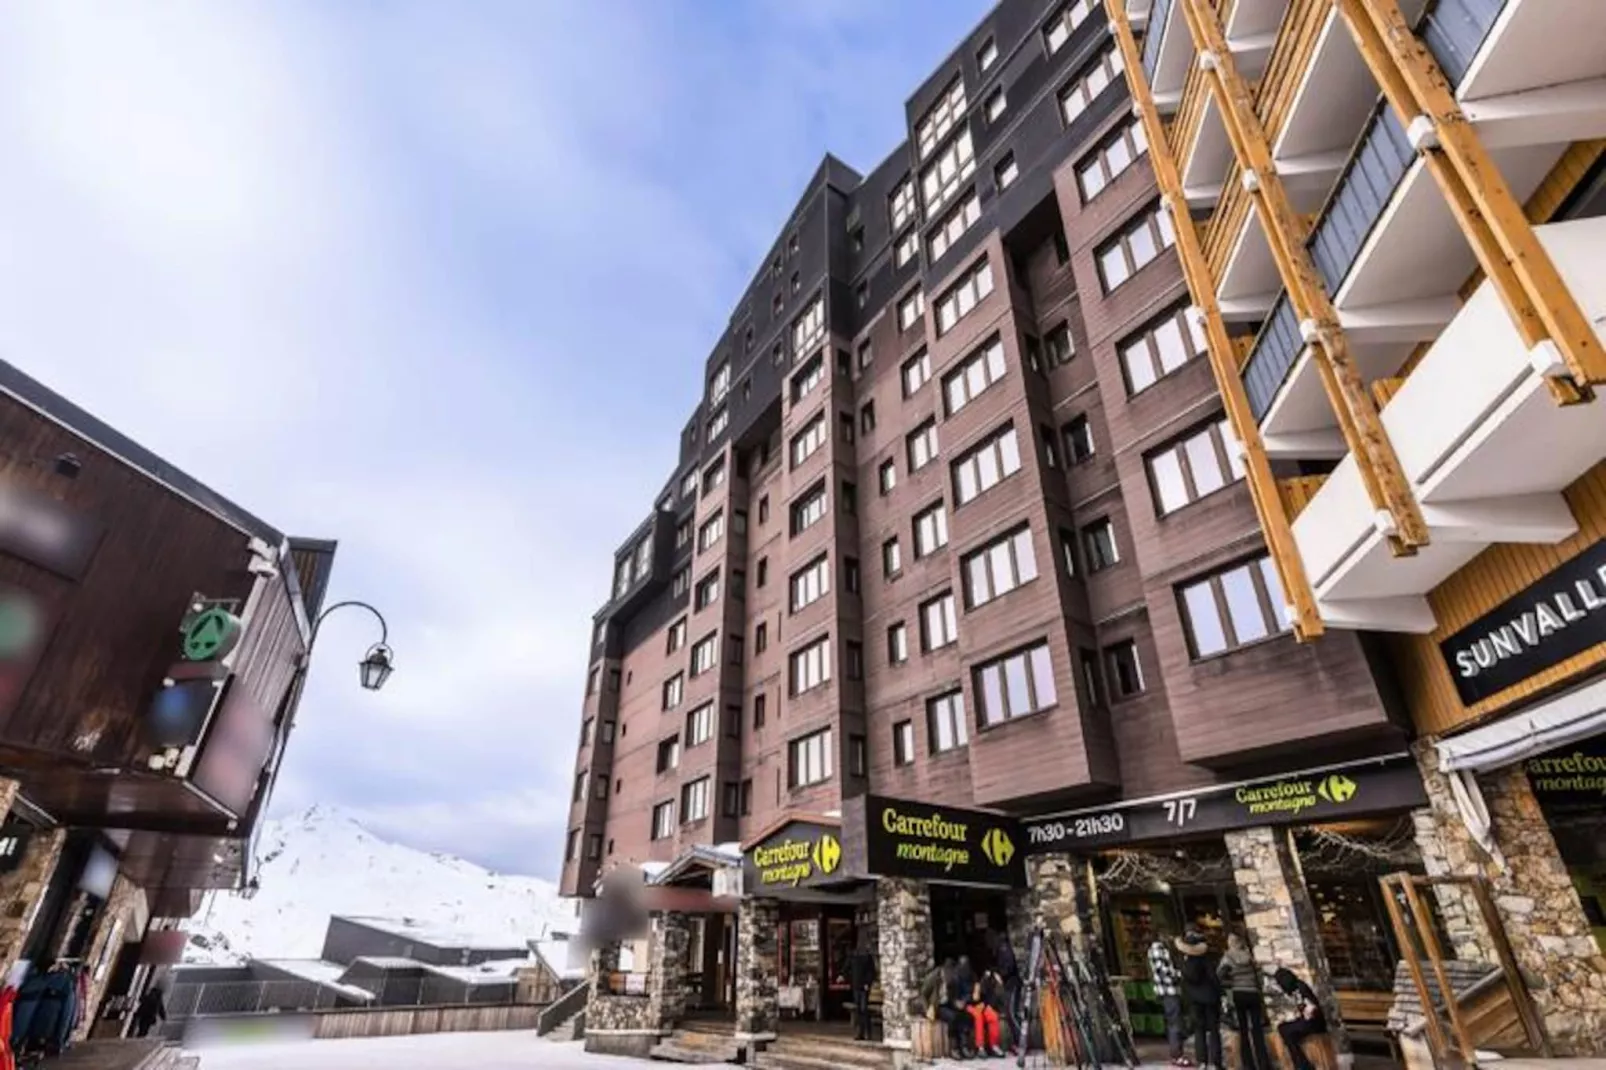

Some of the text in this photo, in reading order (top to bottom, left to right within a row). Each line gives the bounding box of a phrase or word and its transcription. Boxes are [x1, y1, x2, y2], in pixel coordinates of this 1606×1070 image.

[1235, 781, 1312, 804] Carrefour
[1249, 795, 1316, 814] montagne
[882, 807, 968, 842] Carrefour
[1027, 823, 1065, 843] 7h30
[1075, 813, 1124, 837] 21h30
[754, 839, 810, 868] Carrefour
[896, 842, 970, 872] montagne
[762, 862, 812, 888] montagne
